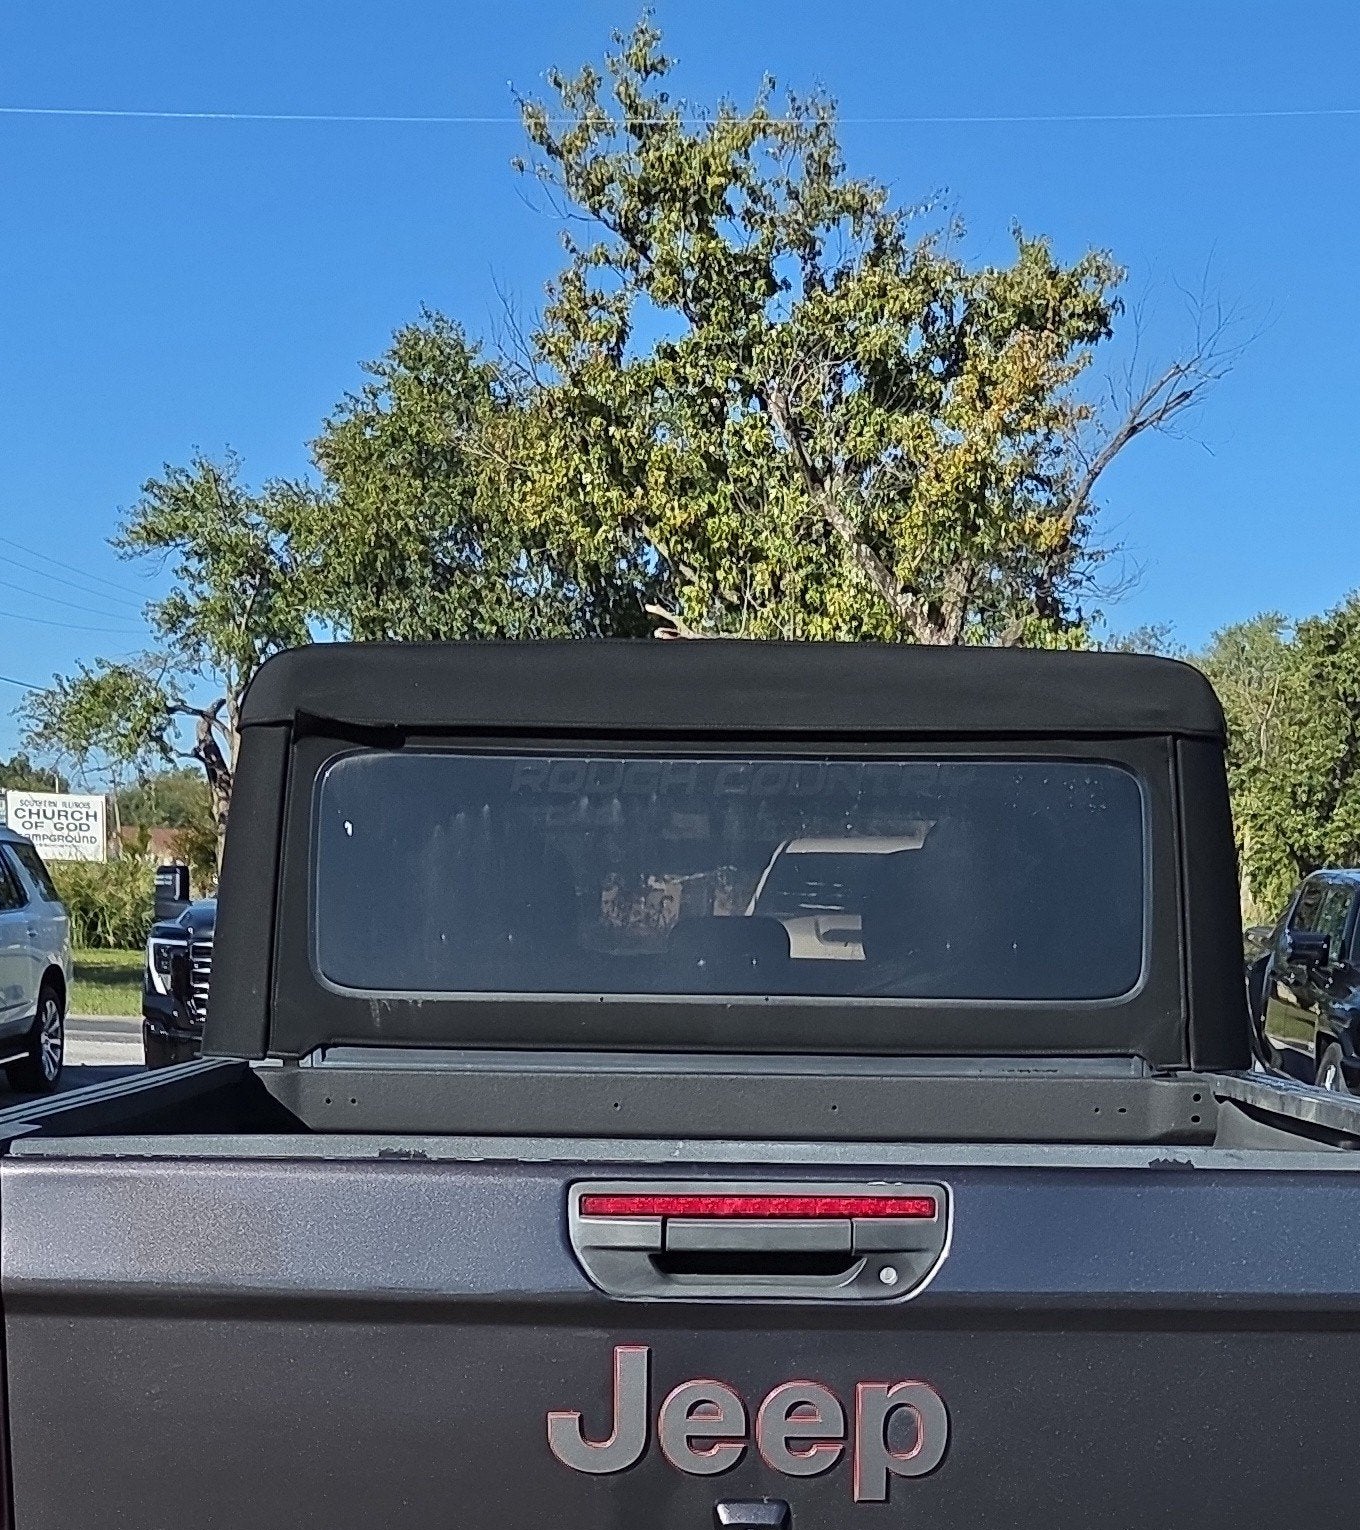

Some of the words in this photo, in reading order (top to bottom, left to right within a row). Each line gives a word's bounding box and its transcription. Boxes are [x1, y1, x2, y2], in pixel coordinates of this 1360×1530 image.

[510, 762, 698, 795] ROUGH
[14, 807, 98, 822] CHURCH
[21, 820, 45, 830] OF
[53, 822, 91, 832] GOD
[547, 1345, 950, 1503] Jeep
